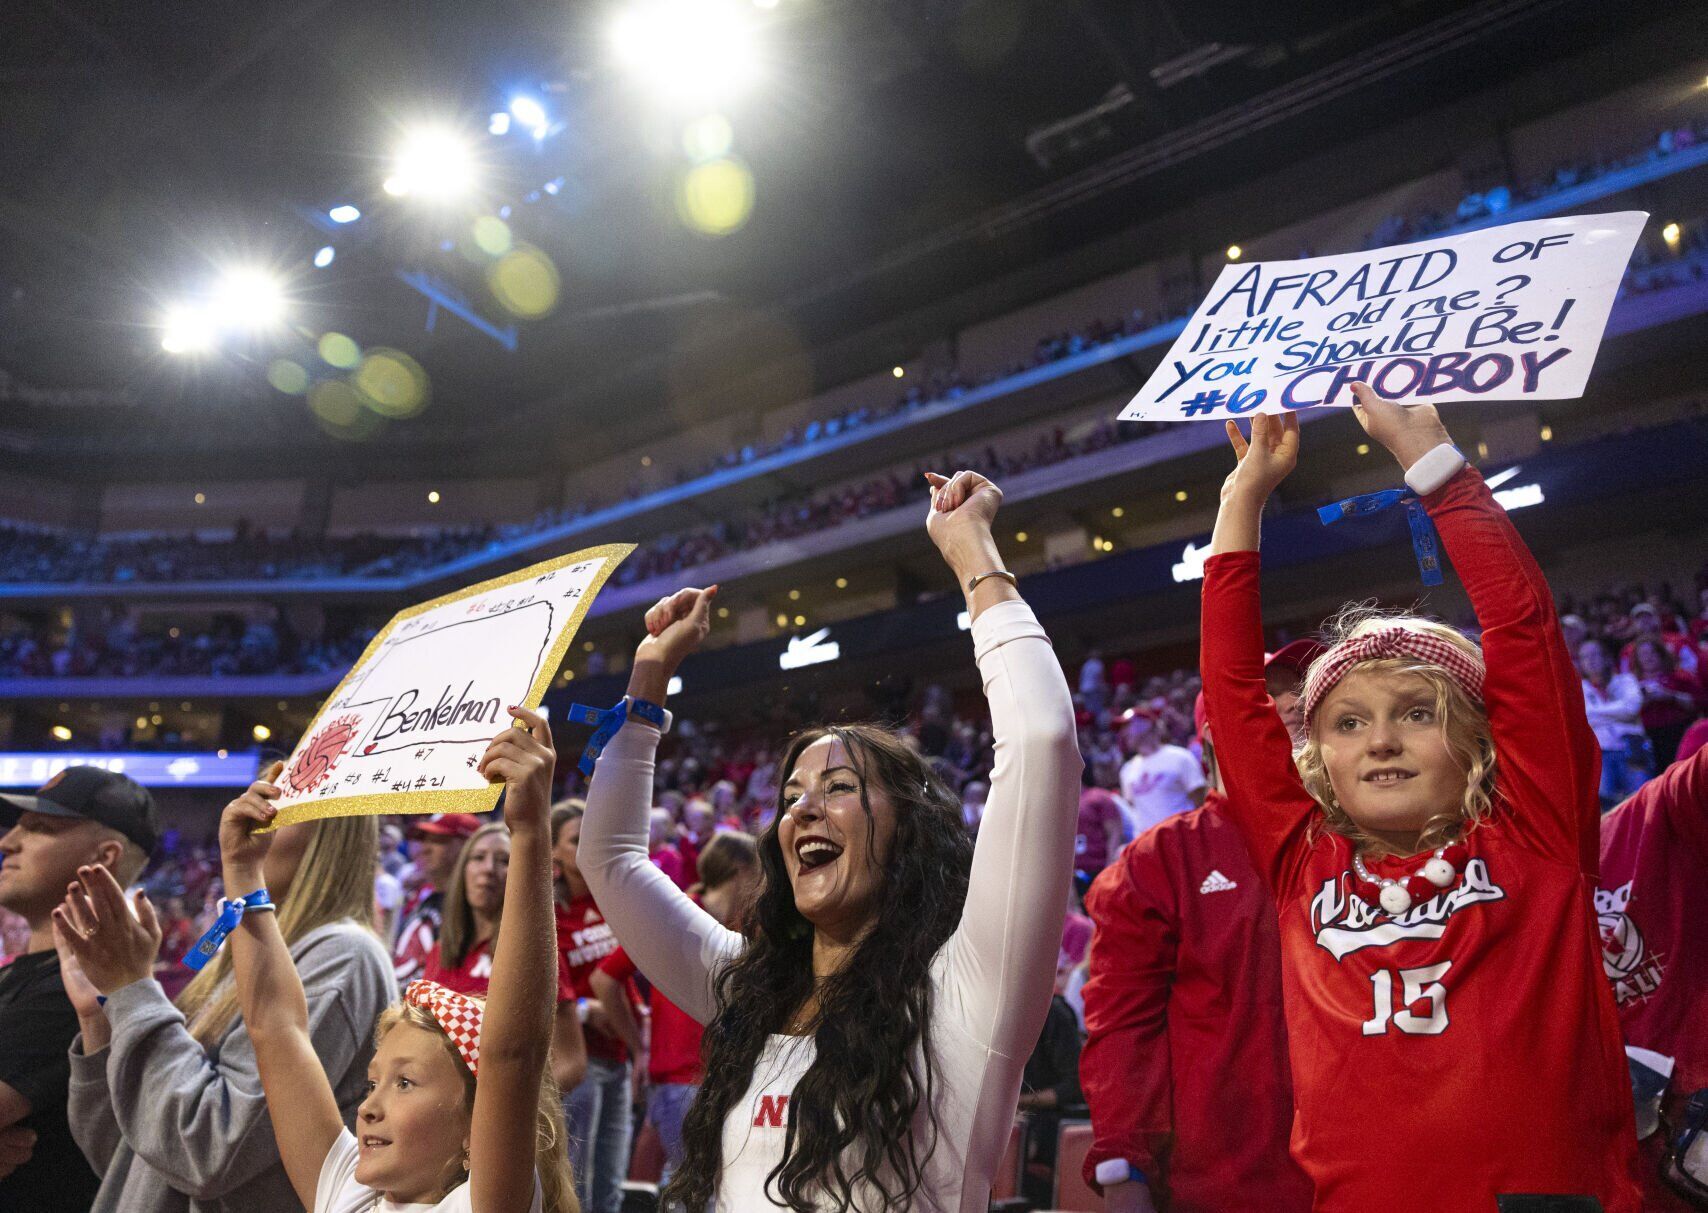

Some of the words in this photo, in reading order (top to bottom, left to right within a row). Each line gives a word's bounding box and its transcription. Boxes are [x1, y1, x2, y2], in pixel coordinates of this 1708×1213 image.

[1206, 249, 1458, 318] AFRAID
[1492, 233, 1575, 263] OF
[1189, 316, 1305, 353] little
[1326, 297, 1396, 331] old
[1154, 356, 1259, 403] You
[1274, 315, 1449, 372] Should
[1464, 298, 1577, 349] Be!
[1180, 382, 1268, 417] #6
[1280, 347, 1573, 409] CHOBOY
[563, 588, 581, 598] #2
[373, 680, 501, 741] Benkelman
[372, 767, 392, 783] #1
[414, 748, 434, 761] #7
[344, 773, 362, 785] #8
[391, 780, 412, 792] #4
[1362, 960, 1453, 1036] 15
[753, 1095, 789, 1128] N
